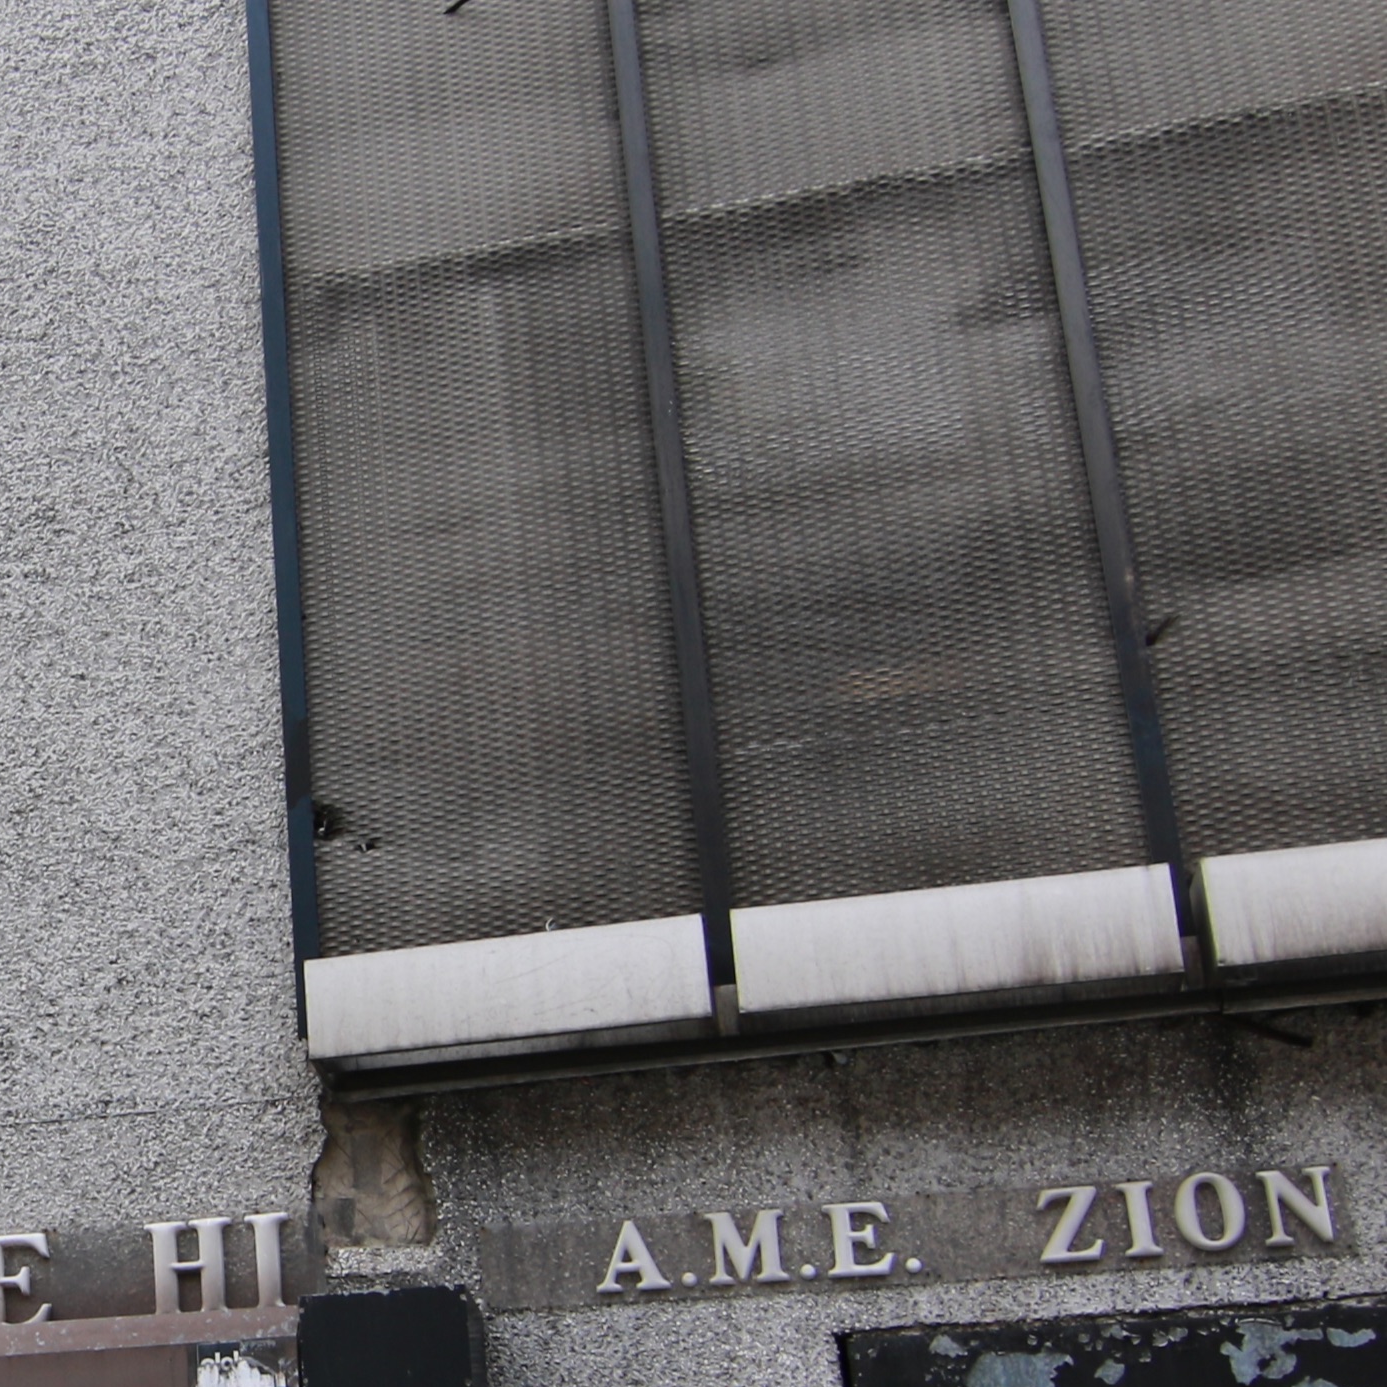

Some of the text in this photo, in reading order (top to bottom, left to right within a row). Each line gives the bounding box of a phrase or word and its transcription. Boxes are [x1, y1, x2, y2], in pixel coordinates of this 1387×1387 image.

[144, 1212, 289, 1315] HI
[596, 1201, 923, 1294] A.M.E.
[1036, 1166, 1335, 1265] ZION
